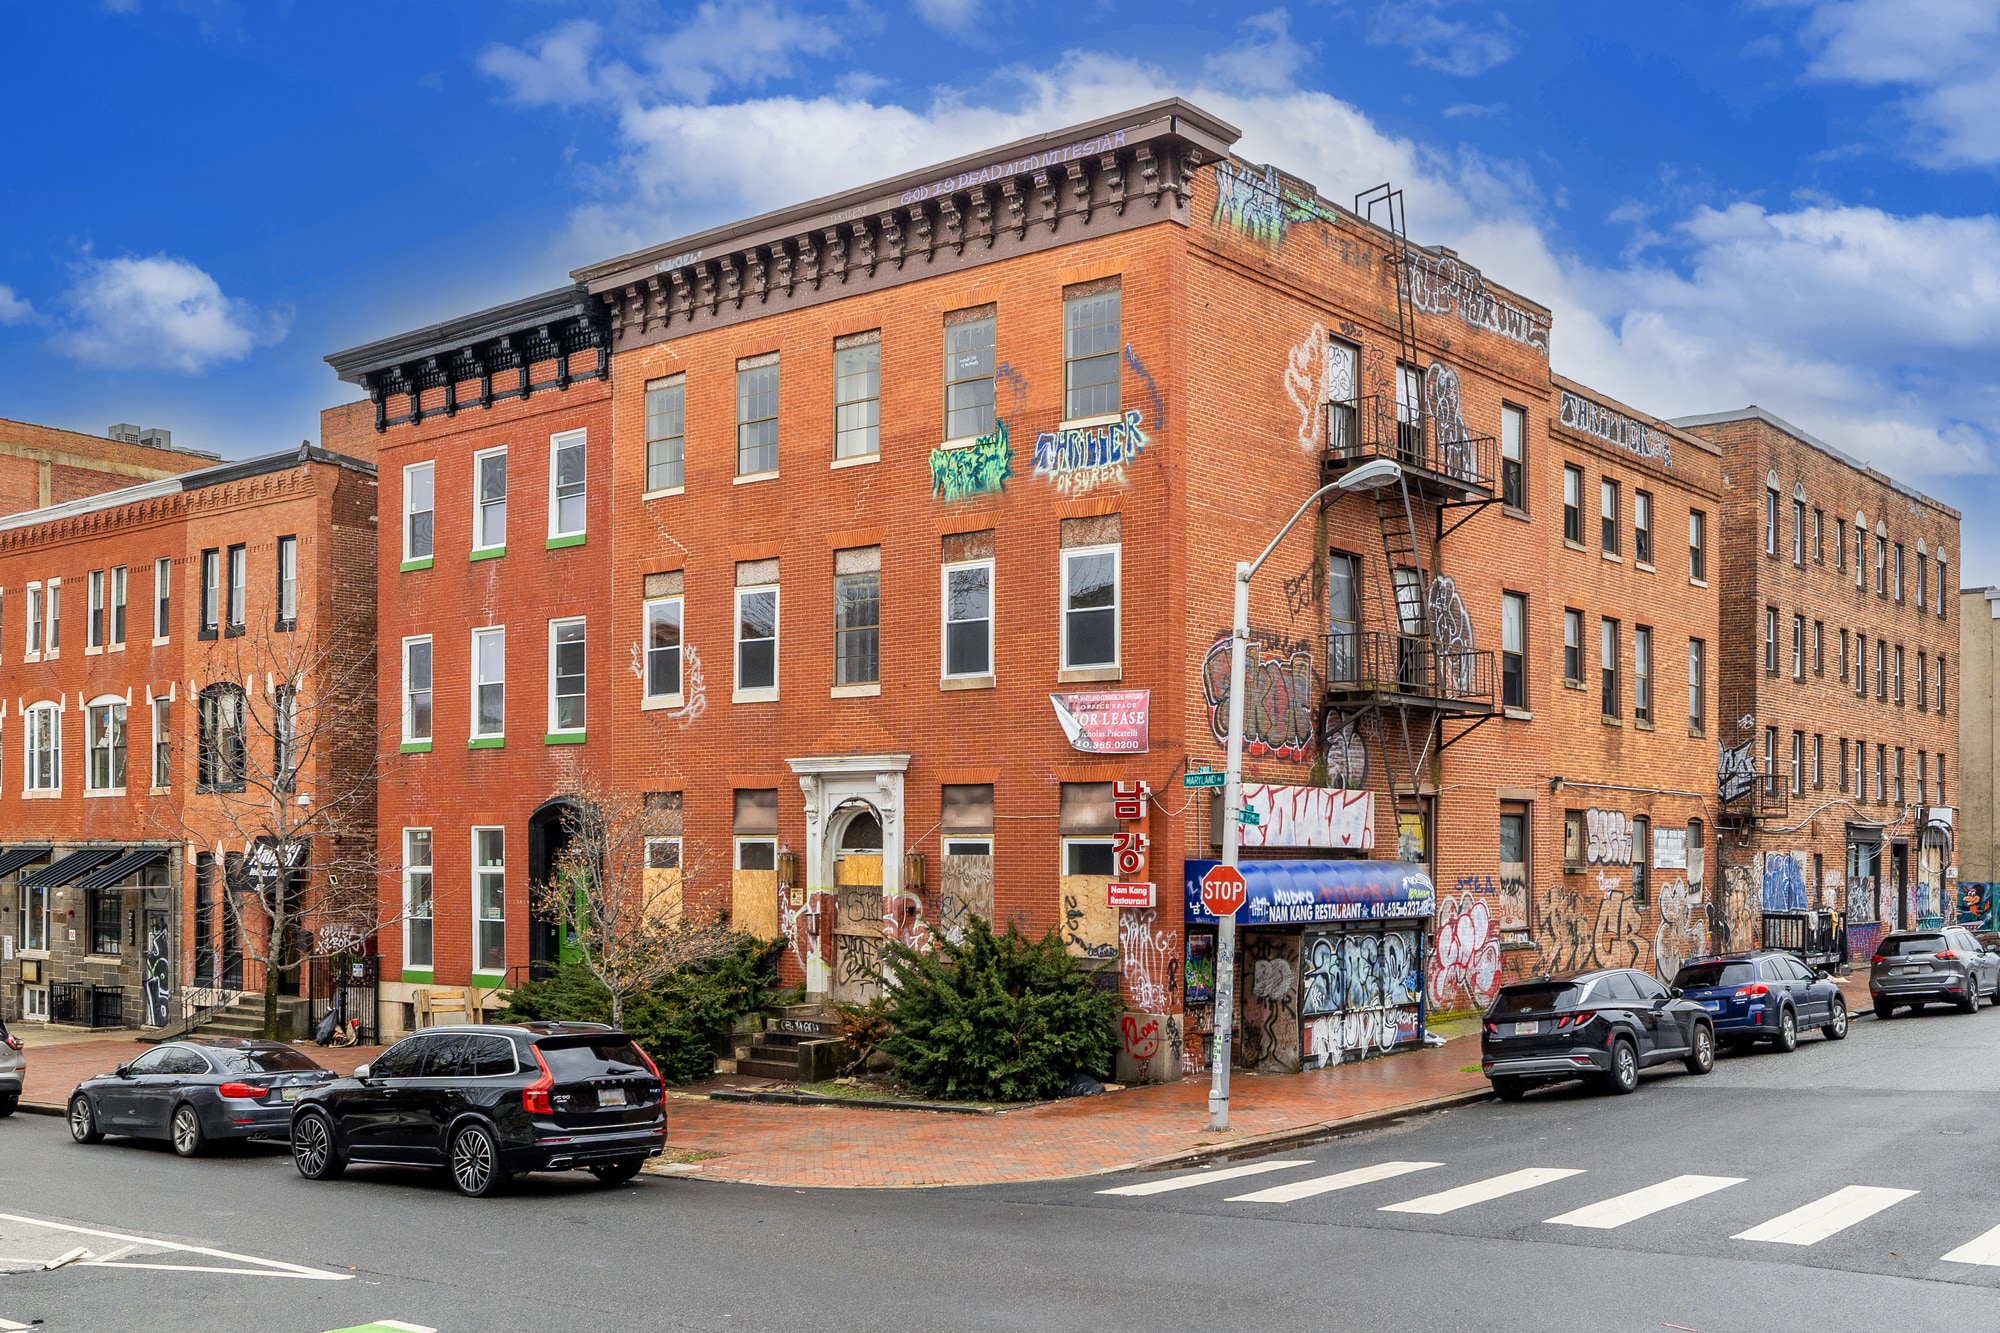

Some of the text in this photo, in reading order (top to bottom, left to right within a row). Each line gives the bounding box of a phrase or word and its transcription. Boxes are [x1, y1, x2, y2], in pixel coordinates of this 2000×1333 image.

[901, 187, 928, 205] GOD
[958, 165, 1002, 190] DEAD
[1080, 703, 1110, 711] OFFICE
[1102, 711, 1145, 725] LEASE
[1080, 730, 1105, 738] icholas
[1185, 775, 1216, 786] MARYLAND
[1110, 885, 1148, 897] Nam Kang
[1204, 881, 1243, 901] STOP
[1110, 896, 1148, 905] Restaurant
[1269, 904, 1288, 922] NAM
[1290, 904, 1313, 921] KANG
[1315, 902, 1361, 919] RESTAURANT
